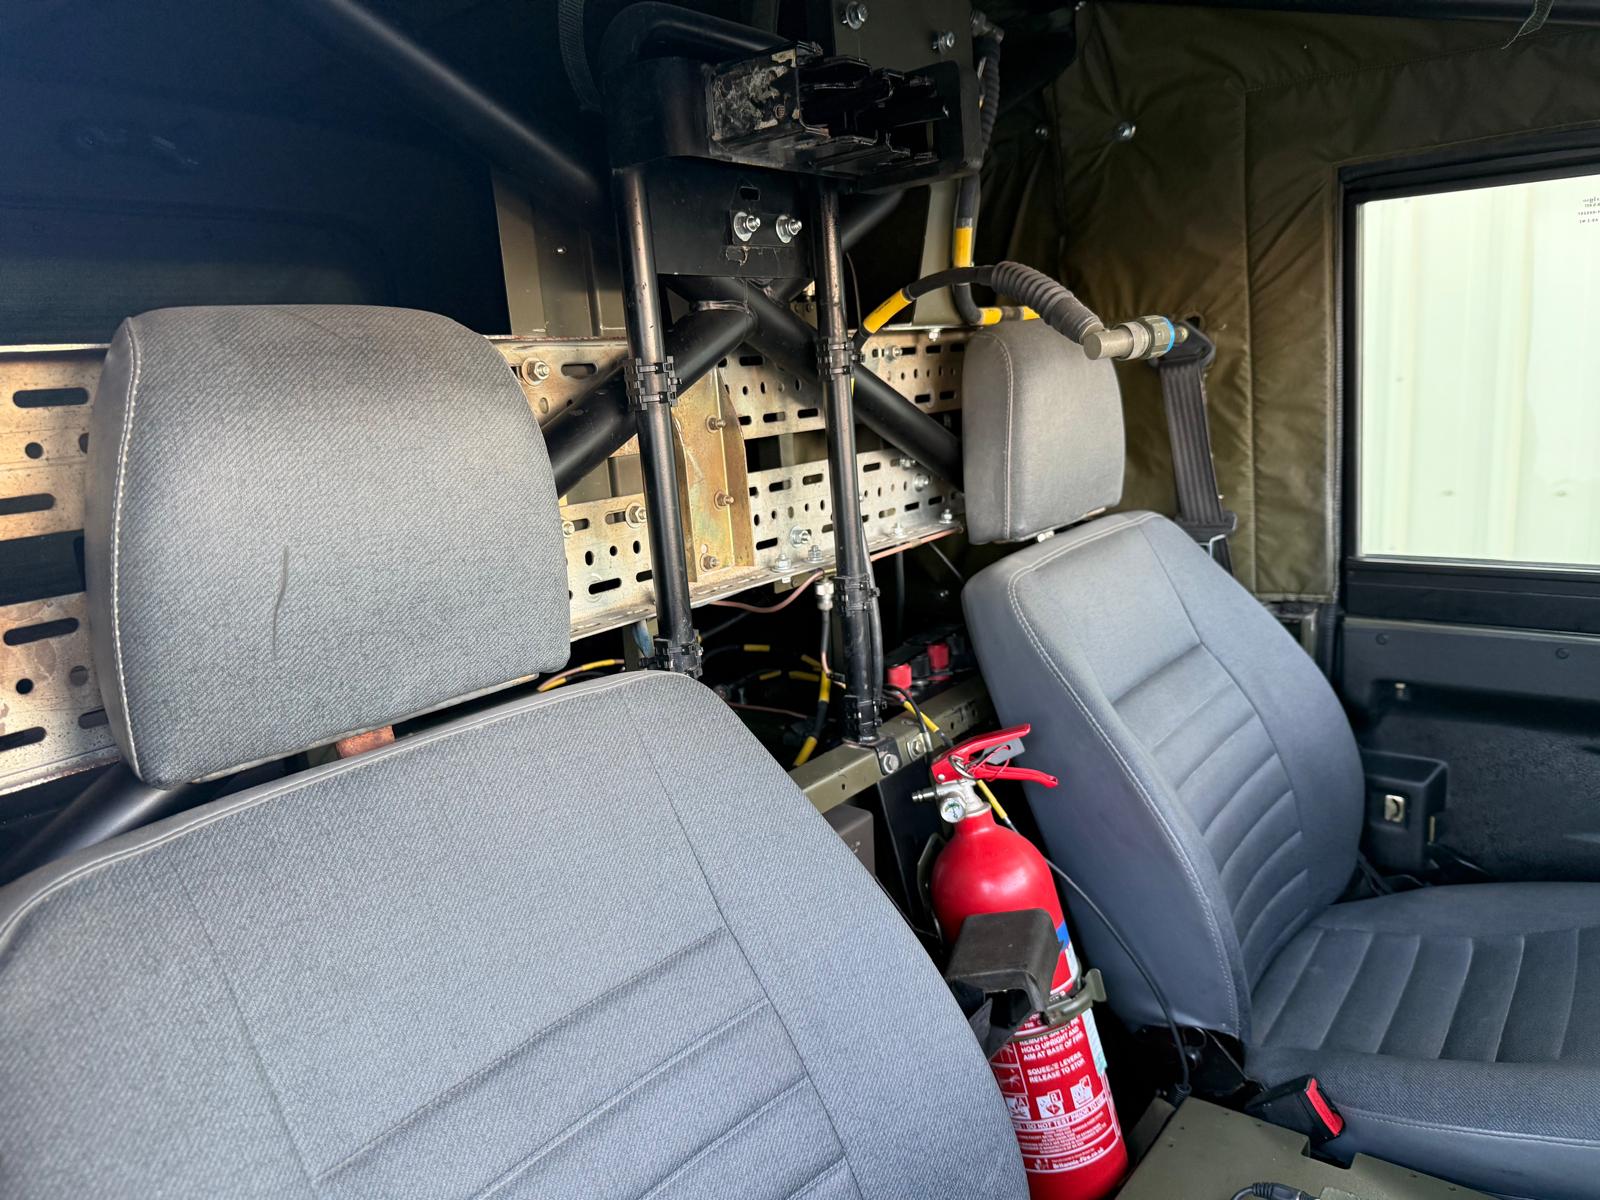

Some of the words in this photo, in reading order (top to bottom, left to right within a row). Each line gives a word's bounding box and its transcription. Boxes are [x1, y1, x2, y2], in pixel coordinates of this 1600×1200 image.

[1021, 1044, 1041, 1054] HOLD
[1041, 1033, 1069, 1049] UPRIGHT
[1023, 1052, 1037, 1061] AIM
[1037, 1050, 1046, 1059] AT
[1046, 1044, 1065, 1056] BASE
[1064, 1039, 1073, 1048] OF
[1027, 1062, 1059, 1076] SQUEEZE
[1029, 1070, 1061, 1083] RELEASE
[1061, 1066, 1071, 1075] TO
